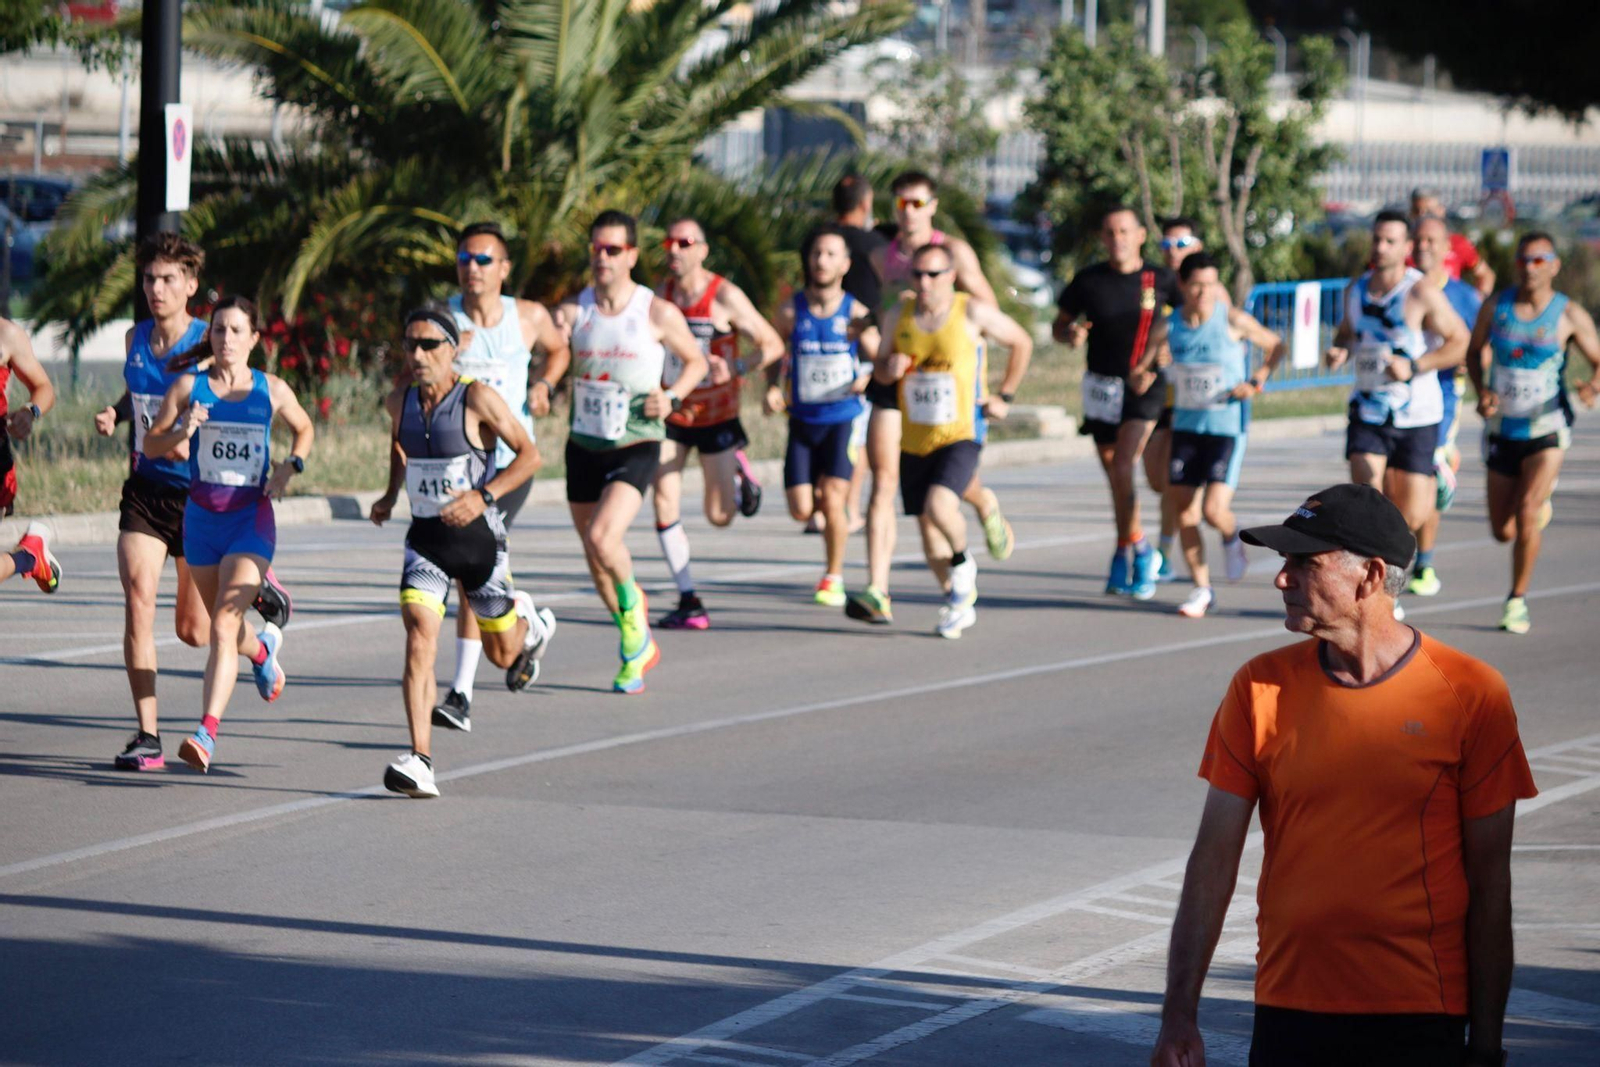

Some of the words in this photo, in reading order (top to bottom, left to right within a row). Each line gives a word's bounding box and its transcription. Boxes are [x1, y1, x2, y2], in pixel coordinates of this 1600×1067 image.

[583, 397, 611, 417] 851
[212, 441, 251, 461] 684
[418, 478, 452, 498] 418
